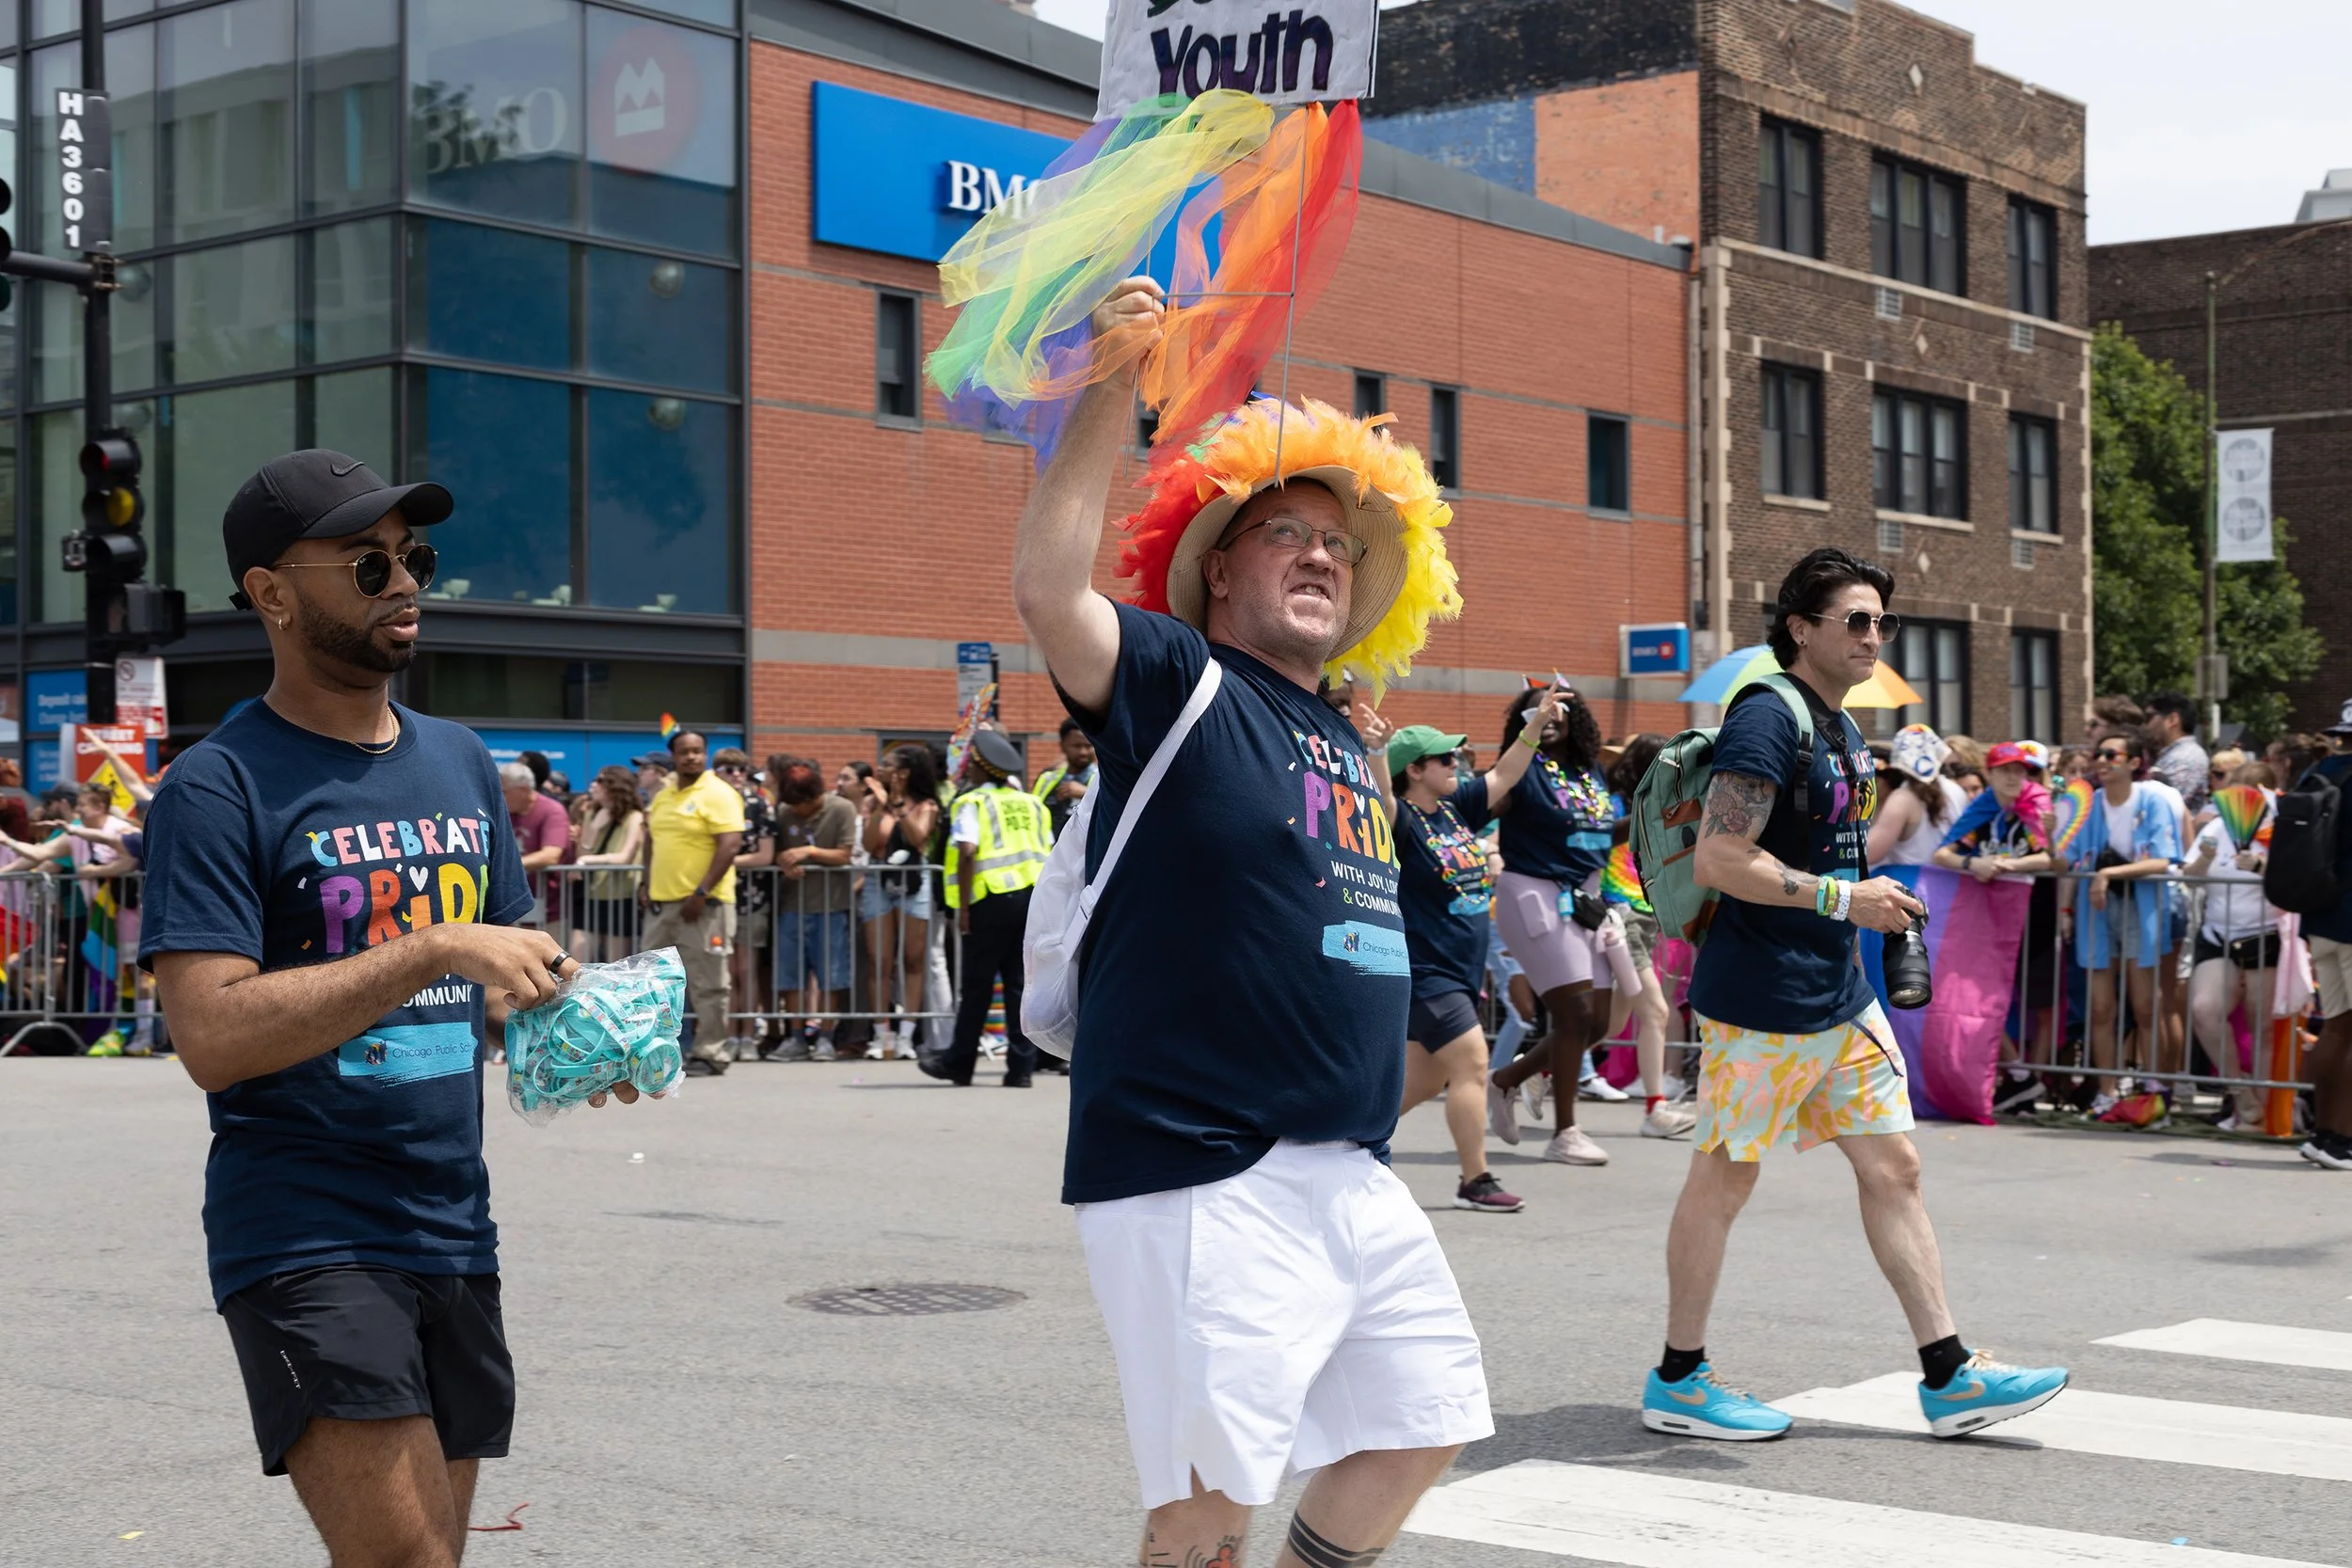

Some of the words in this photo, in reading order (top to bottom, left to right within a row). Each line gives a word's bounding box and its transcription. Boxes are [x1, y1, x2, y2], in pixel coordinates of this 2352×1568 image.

[1151, 9, 1333, 105] Youth
[58, 91, 84, 247] HA3601
[1331, 861, 1365, 884] WITH
[1368, 872, 1388, 894] JOY,
[1343, 888, 1353, 904] &
[1362, 942, 1391, 957] Chicago
[392, 1048, 433, 1063] Chicago
[436, 1044, 457, 1057] Public
